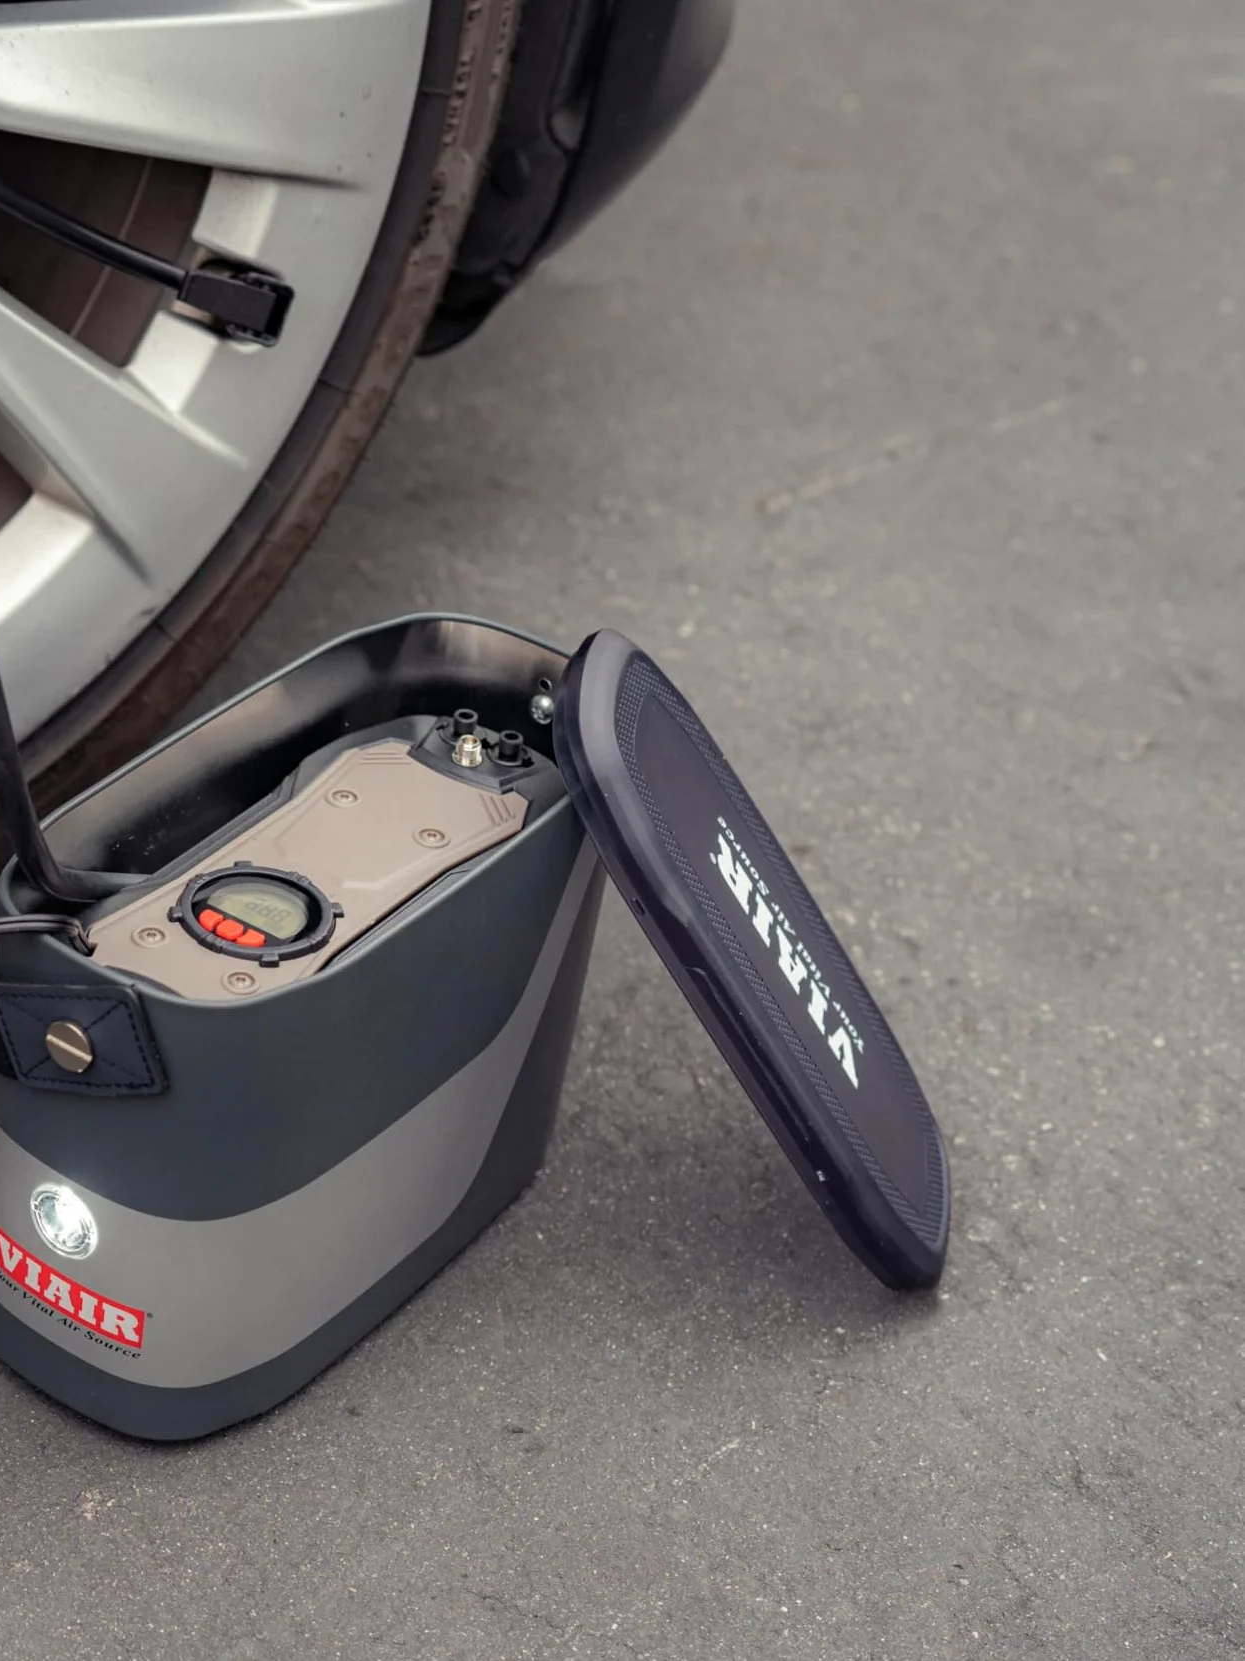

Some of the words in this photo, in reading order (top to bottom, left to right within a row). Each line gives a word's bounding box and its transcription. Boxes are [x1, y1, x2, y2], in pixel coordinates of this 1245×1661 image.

[716, 815, 771, 897] Source
[771, 901, 796, 936] Air
[717, 832, 859, 1090] VIAIR
[796, 941, 832, 1000] Vital
[832, 1000, 865, 1055] Your
[23, 1290, 55, 1318] Vital
[57, 1317, 81, 1333] Air
[84, 1330, 142, 1360] Source
